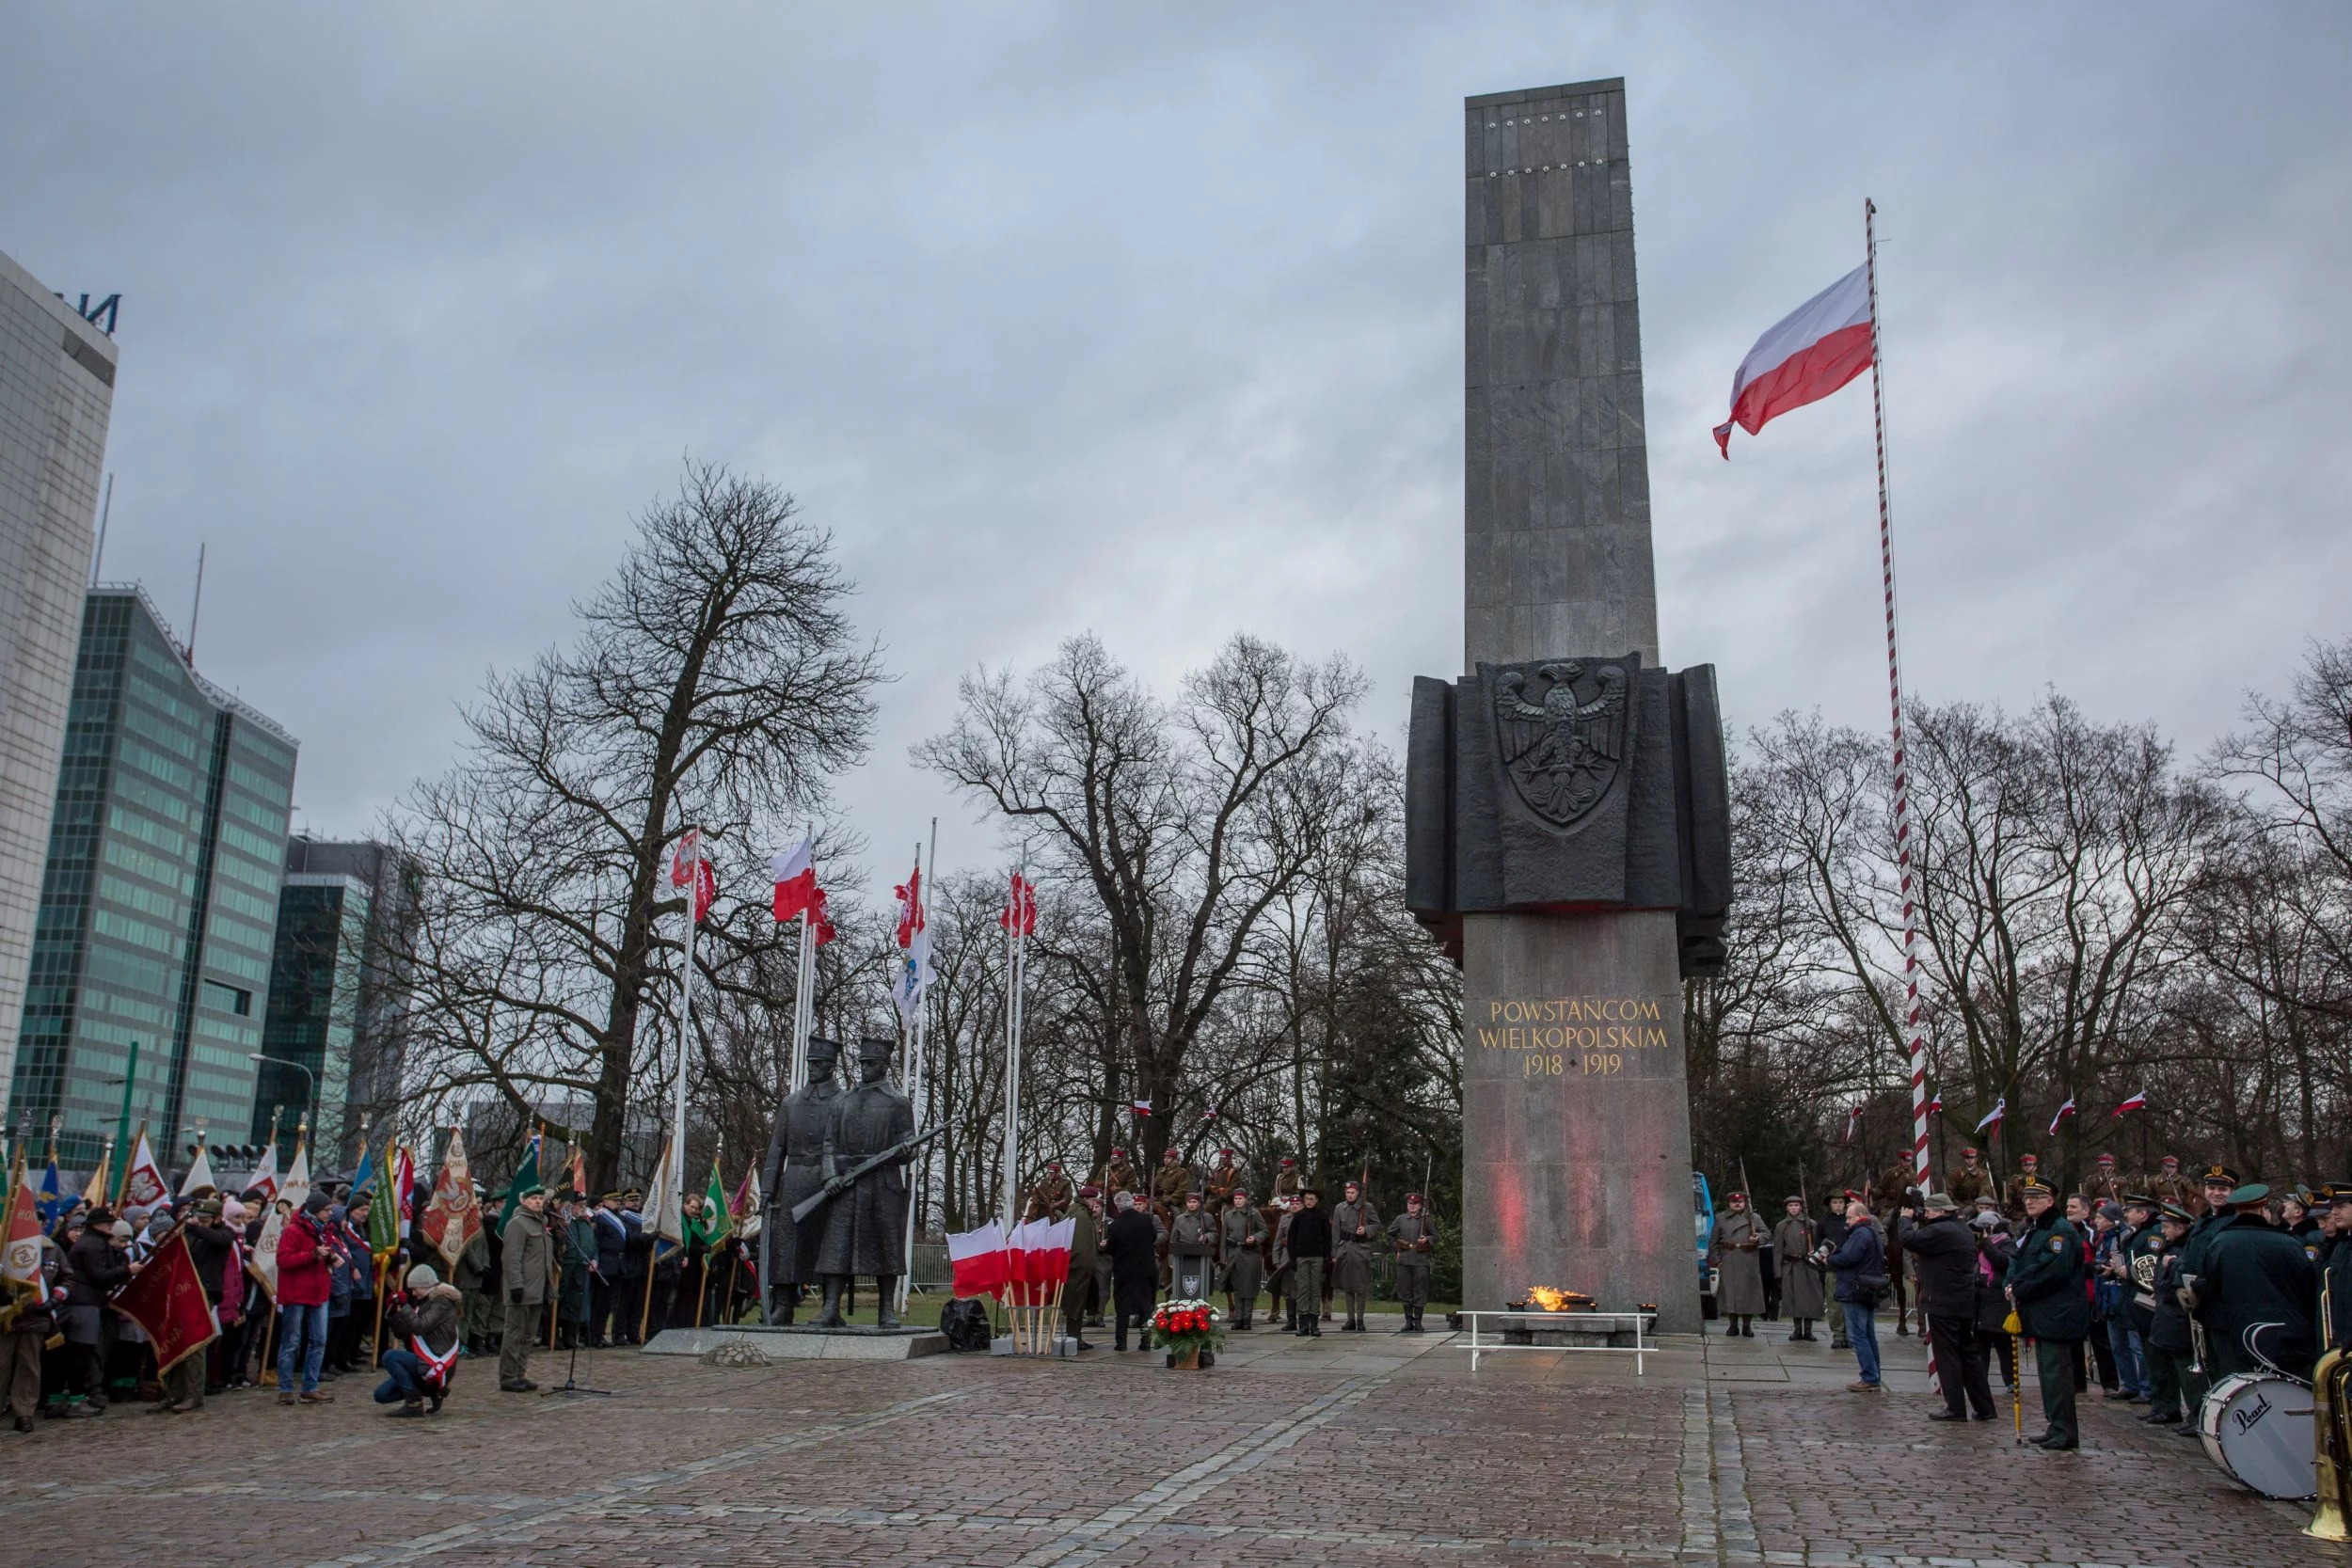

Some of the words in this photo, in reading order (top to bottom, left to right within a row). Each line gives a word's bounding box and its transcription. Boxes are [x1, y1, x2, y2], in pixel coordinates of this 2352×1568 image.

[1478, 1026, 1669, 1050] WIELKOPOLSKIM
[1524, 1053, 1564, 1076] 1918
[1583, 1053, 1622, 1076] 1919
[2232, 1392, 2269, 1436] Pearl
